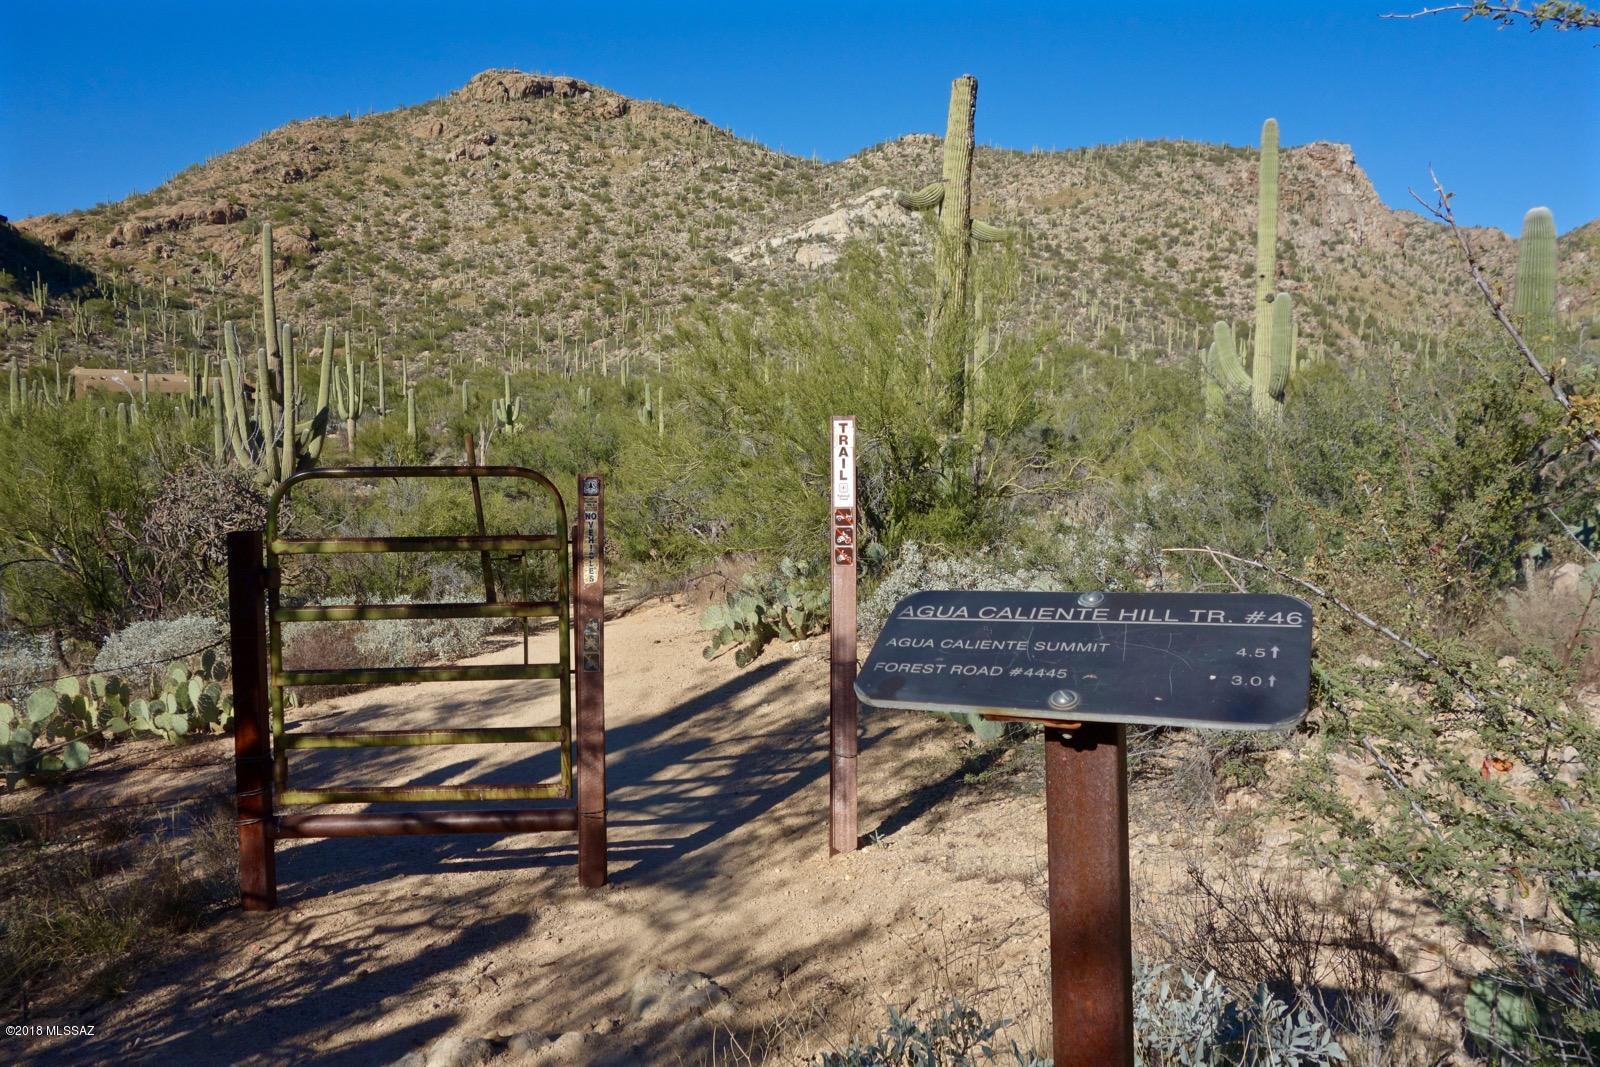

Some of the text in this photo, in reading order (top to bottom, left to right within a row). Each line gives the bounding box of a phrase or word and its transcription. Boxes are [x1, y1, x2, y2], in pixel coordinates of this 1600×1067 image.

[838, 422, 849, 480] TRAIL
[585, 512, 597, 520] NO
[899, 605, 1304, 626] AGUA CALIENTE HILL TR. #46
[885, 637, 1110, 653] AGUA CALIENTE SUMMIT
[1235, 648, 1266, 658] 4.5
[873, 662, 1068, 679] FOREST ROAD #4445
[1230, 675, 1262, 686] 3.0
